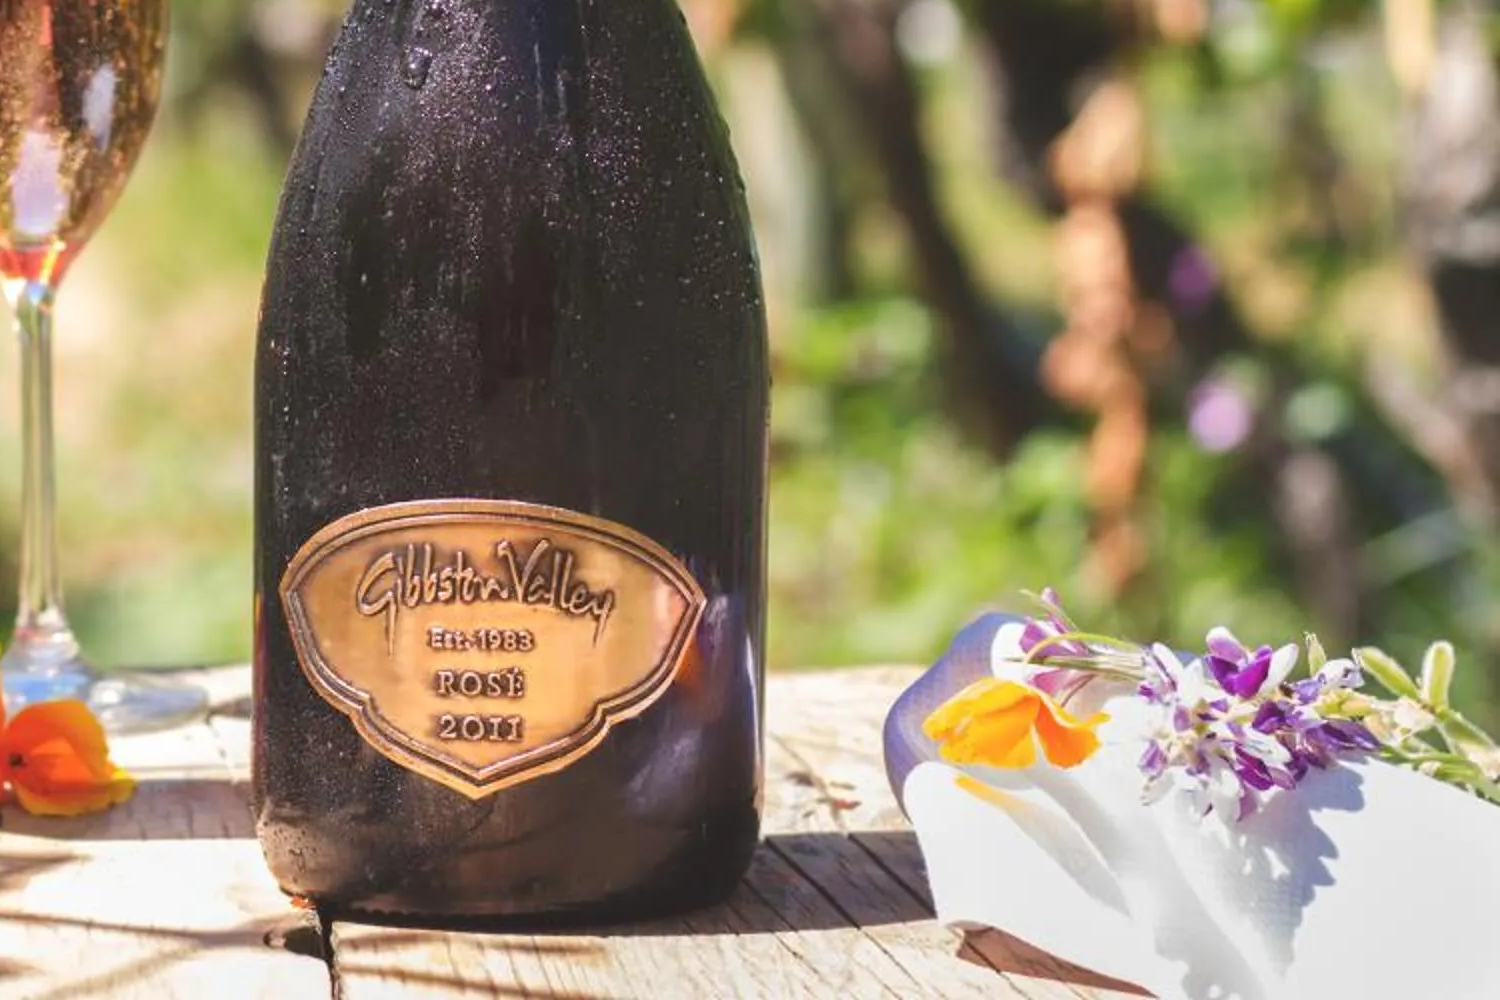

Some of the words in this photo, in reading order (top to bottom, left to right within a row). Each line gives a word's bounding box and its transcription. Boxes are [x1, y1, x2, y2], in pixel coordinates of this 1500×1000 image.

[496, 537, 615, 648] Valley
[477, 628, 534, 652] 1983
[437, 667, 524, 697] ROSÉ
[439, 714, 522, 741] 2011
